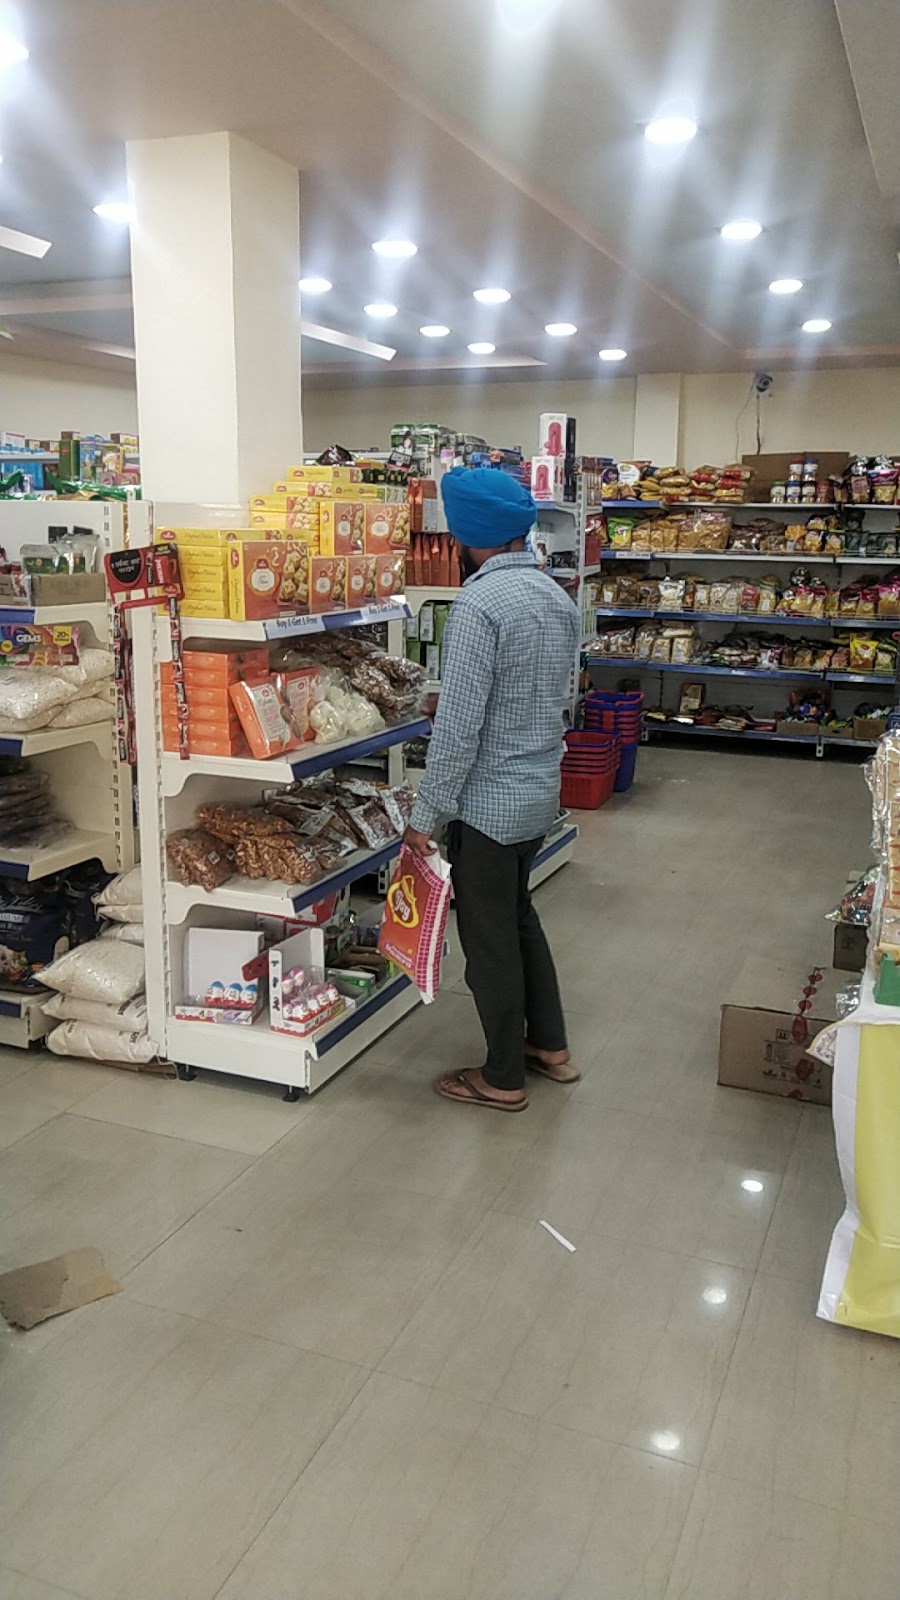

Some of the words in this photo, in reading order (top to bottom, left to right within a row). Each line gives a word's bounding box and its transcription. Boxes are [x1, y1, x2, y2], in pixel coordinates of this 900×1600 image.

[276, 619, 287, 630] Buy
[291, 617, 302, 626] Get
[306, 616, 317, 625] Free
[16, 634, 42, 643] GEMS
